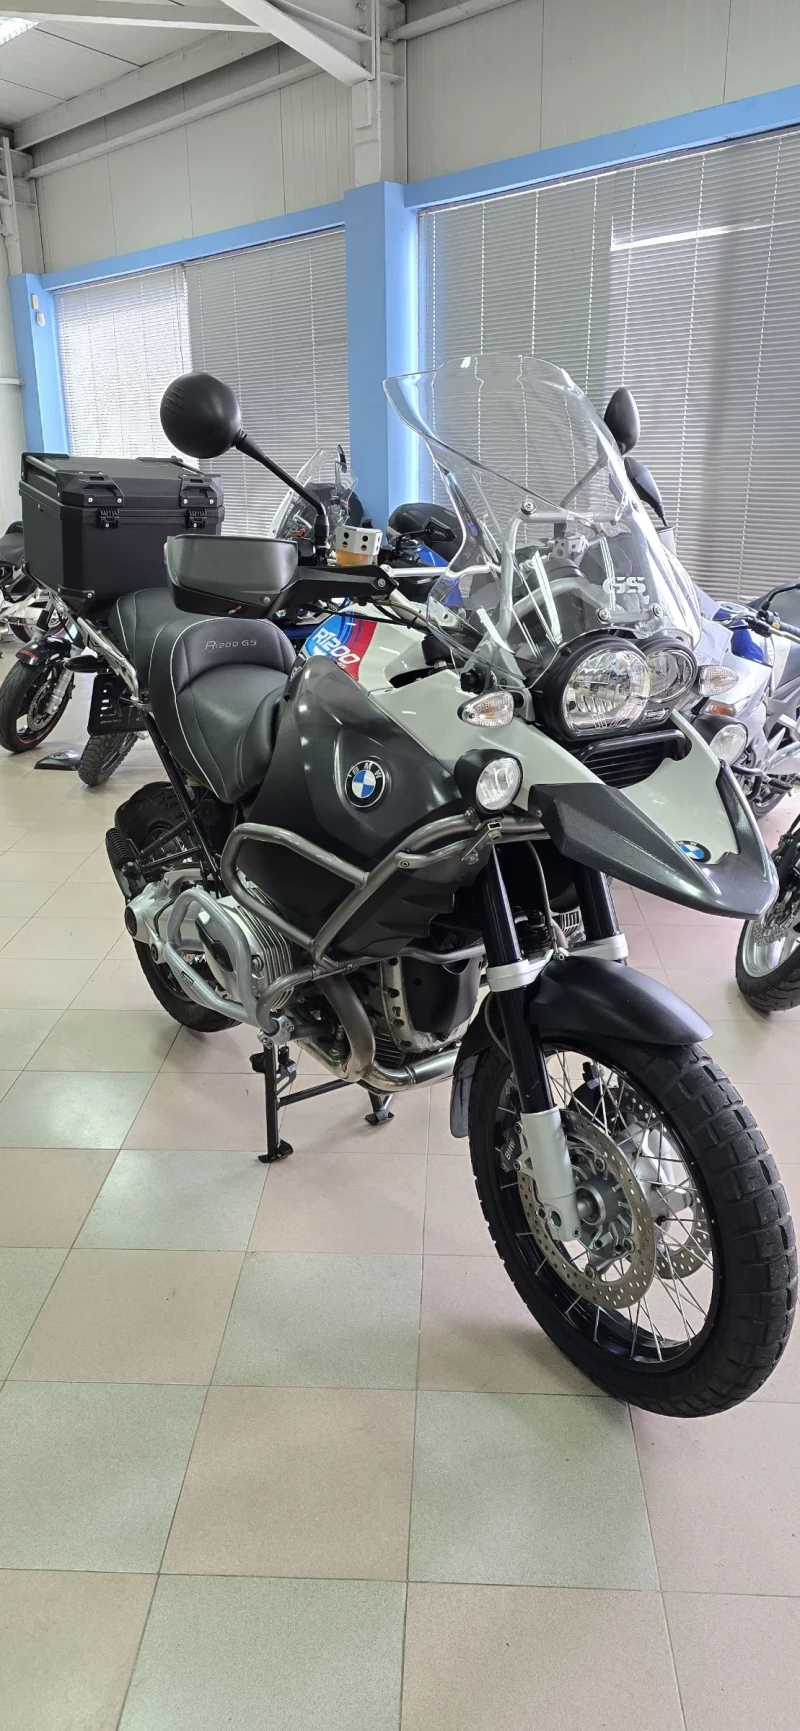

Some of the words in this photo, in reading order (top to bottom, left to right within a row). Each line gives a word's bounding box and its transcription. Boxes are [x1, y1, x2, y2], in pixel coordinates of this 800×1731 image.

[603, 576, 646, 594] GS
[241, 639, 258, 647] GS
[312, 627, 361, 664] R1200
[352, 762, 383, 779] BMW
[504, 1138, 516, 1161] BMW
